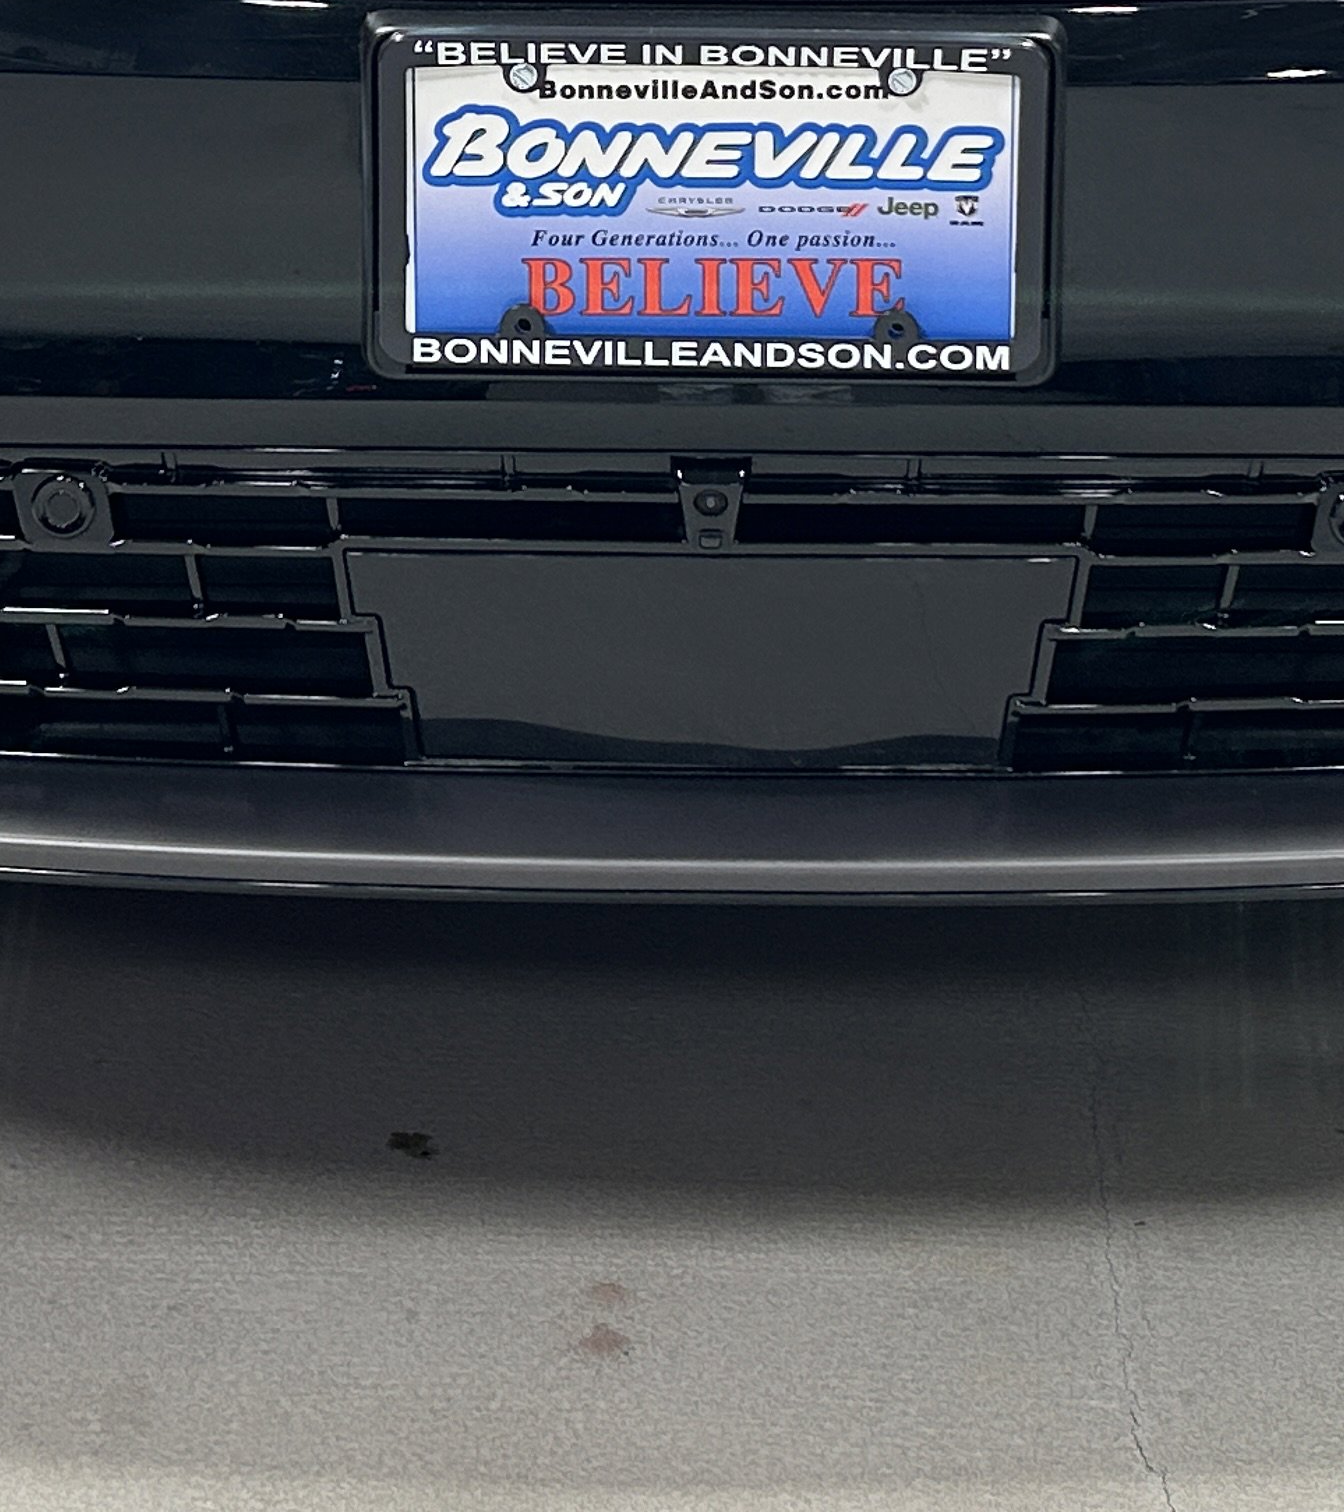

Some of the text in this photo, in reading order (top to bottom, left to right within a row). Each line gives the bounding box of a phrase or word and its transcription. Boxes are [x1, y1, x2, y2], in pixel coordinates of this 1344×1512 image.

[641, 44, 684, 66] IN
[538, 79, 889, 101] BonnevilleAndSon.com
[428, 110, 996, 183] BONNEVILLE
[877, 196, 940, 220] Jeep
[530, 229, 897, 251] Four Generations... One passion...
[521, 257, 905, 319] BELIEVE
[412, 337, 1011, 372] BONNEVILLEANDSON.COM
